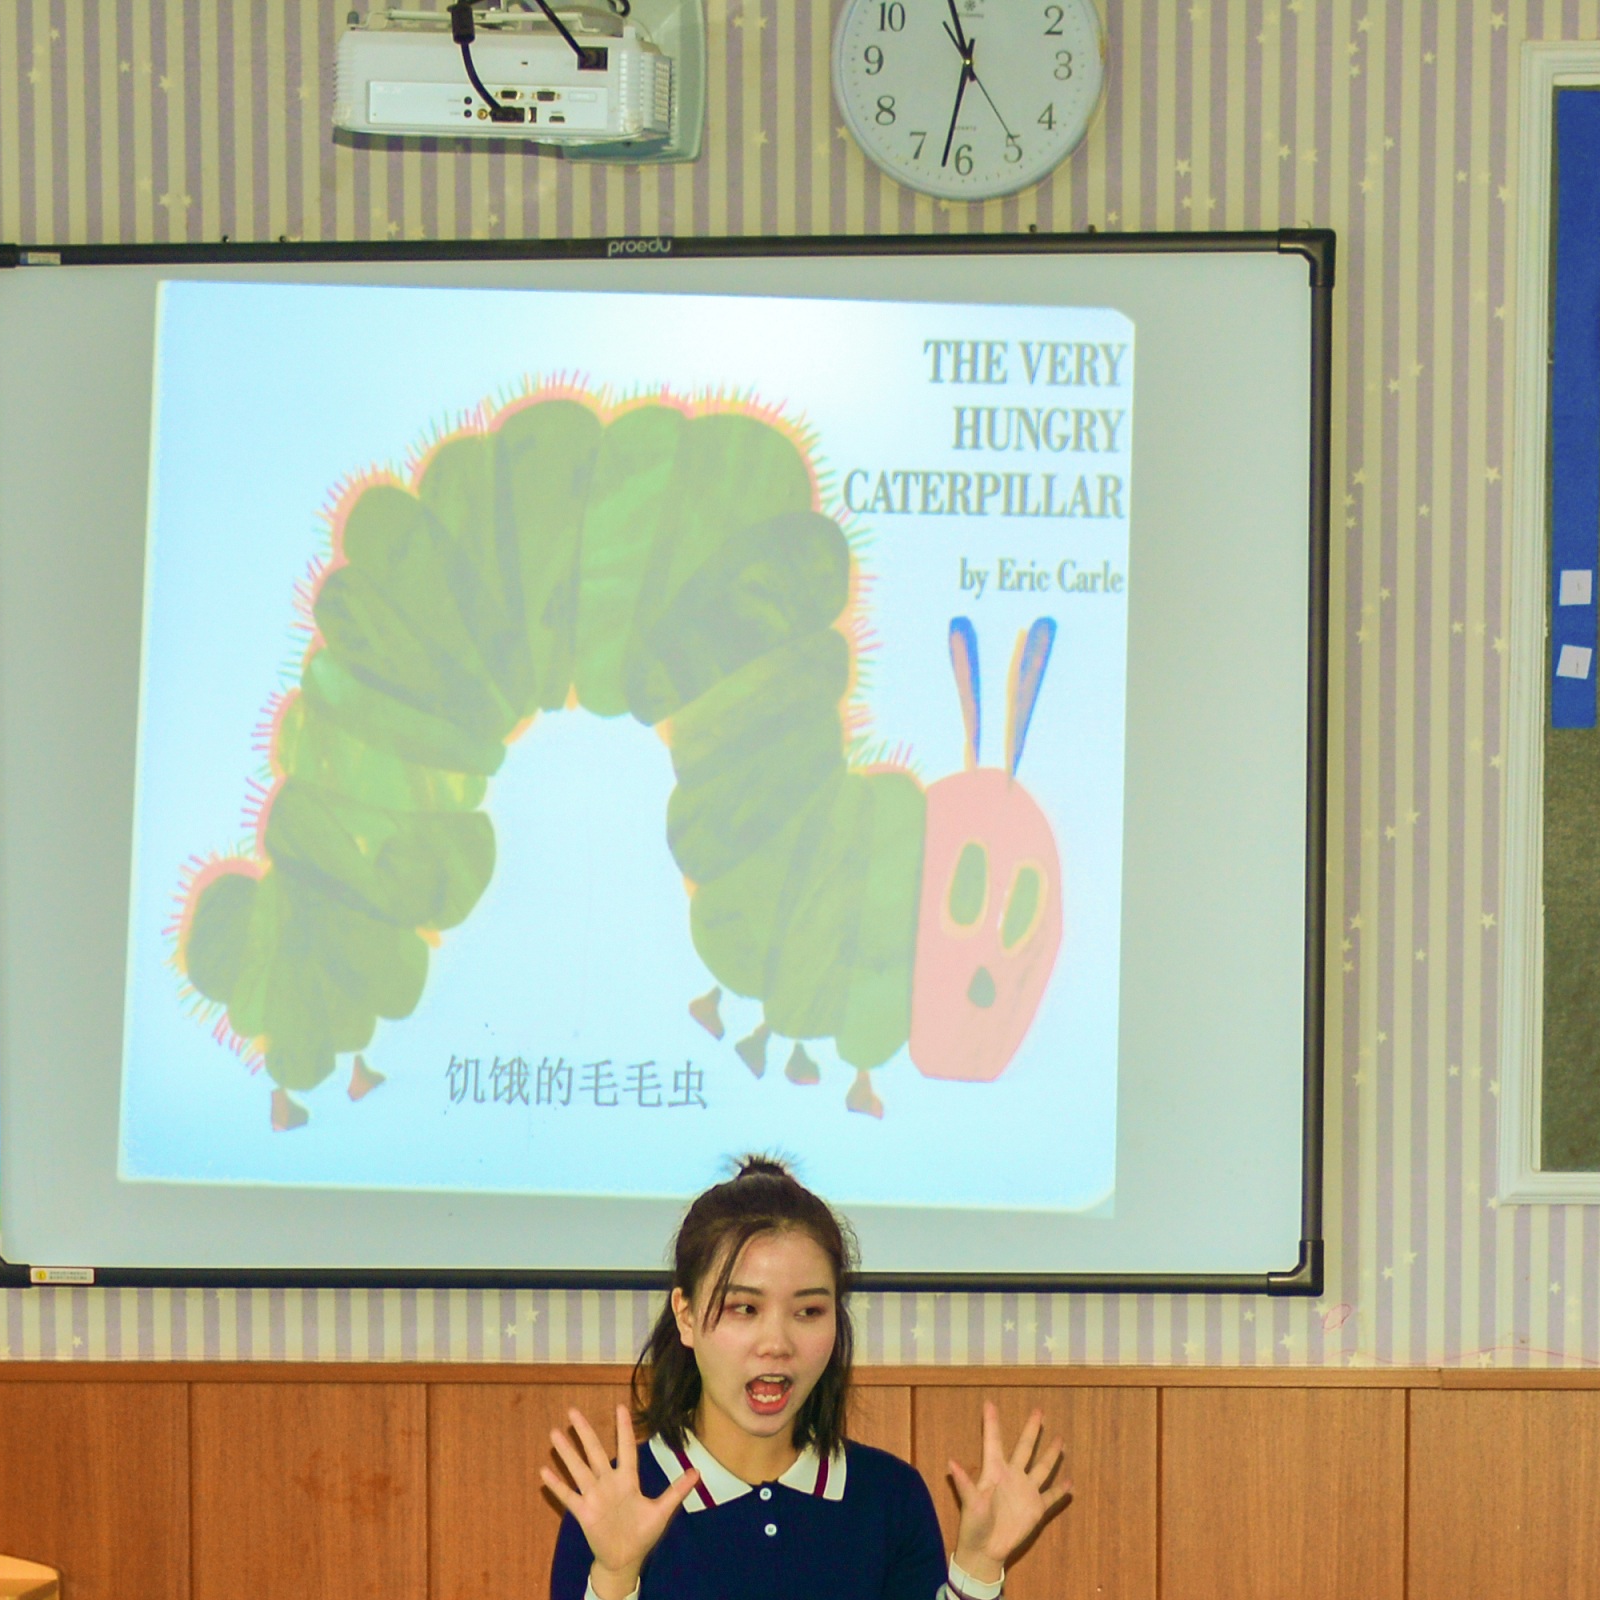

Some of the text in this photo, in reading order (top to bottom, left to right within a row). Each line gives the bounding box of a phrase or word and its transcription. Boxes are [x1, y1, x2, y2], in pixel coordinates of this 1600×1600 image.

[878, 2, 906, 32] 10
[1043, 5, 1065, 36] 2
[863, 45, 885, 75] 9
[1053, 50, 1073, 80] 3
[874, 95, 897, 126] 8
[1036, 102, 1057, 130] 4
[909, 131, 927, 160] 7
[954, 144, 973, 176] 6
[1002, 134, 1023, 163] 5
[607, 237, 672, 257] proedu
[923, 339, 1127, 387] THE VERY
[951, 406, 1126, 453] HUNGRY
[843, 468, 1125, 519] CATERPILLAR
[959, 556, 1124, 600] by Eric Carle
[445, 1054, 707, 1110] 饥饿的毛毛虫
